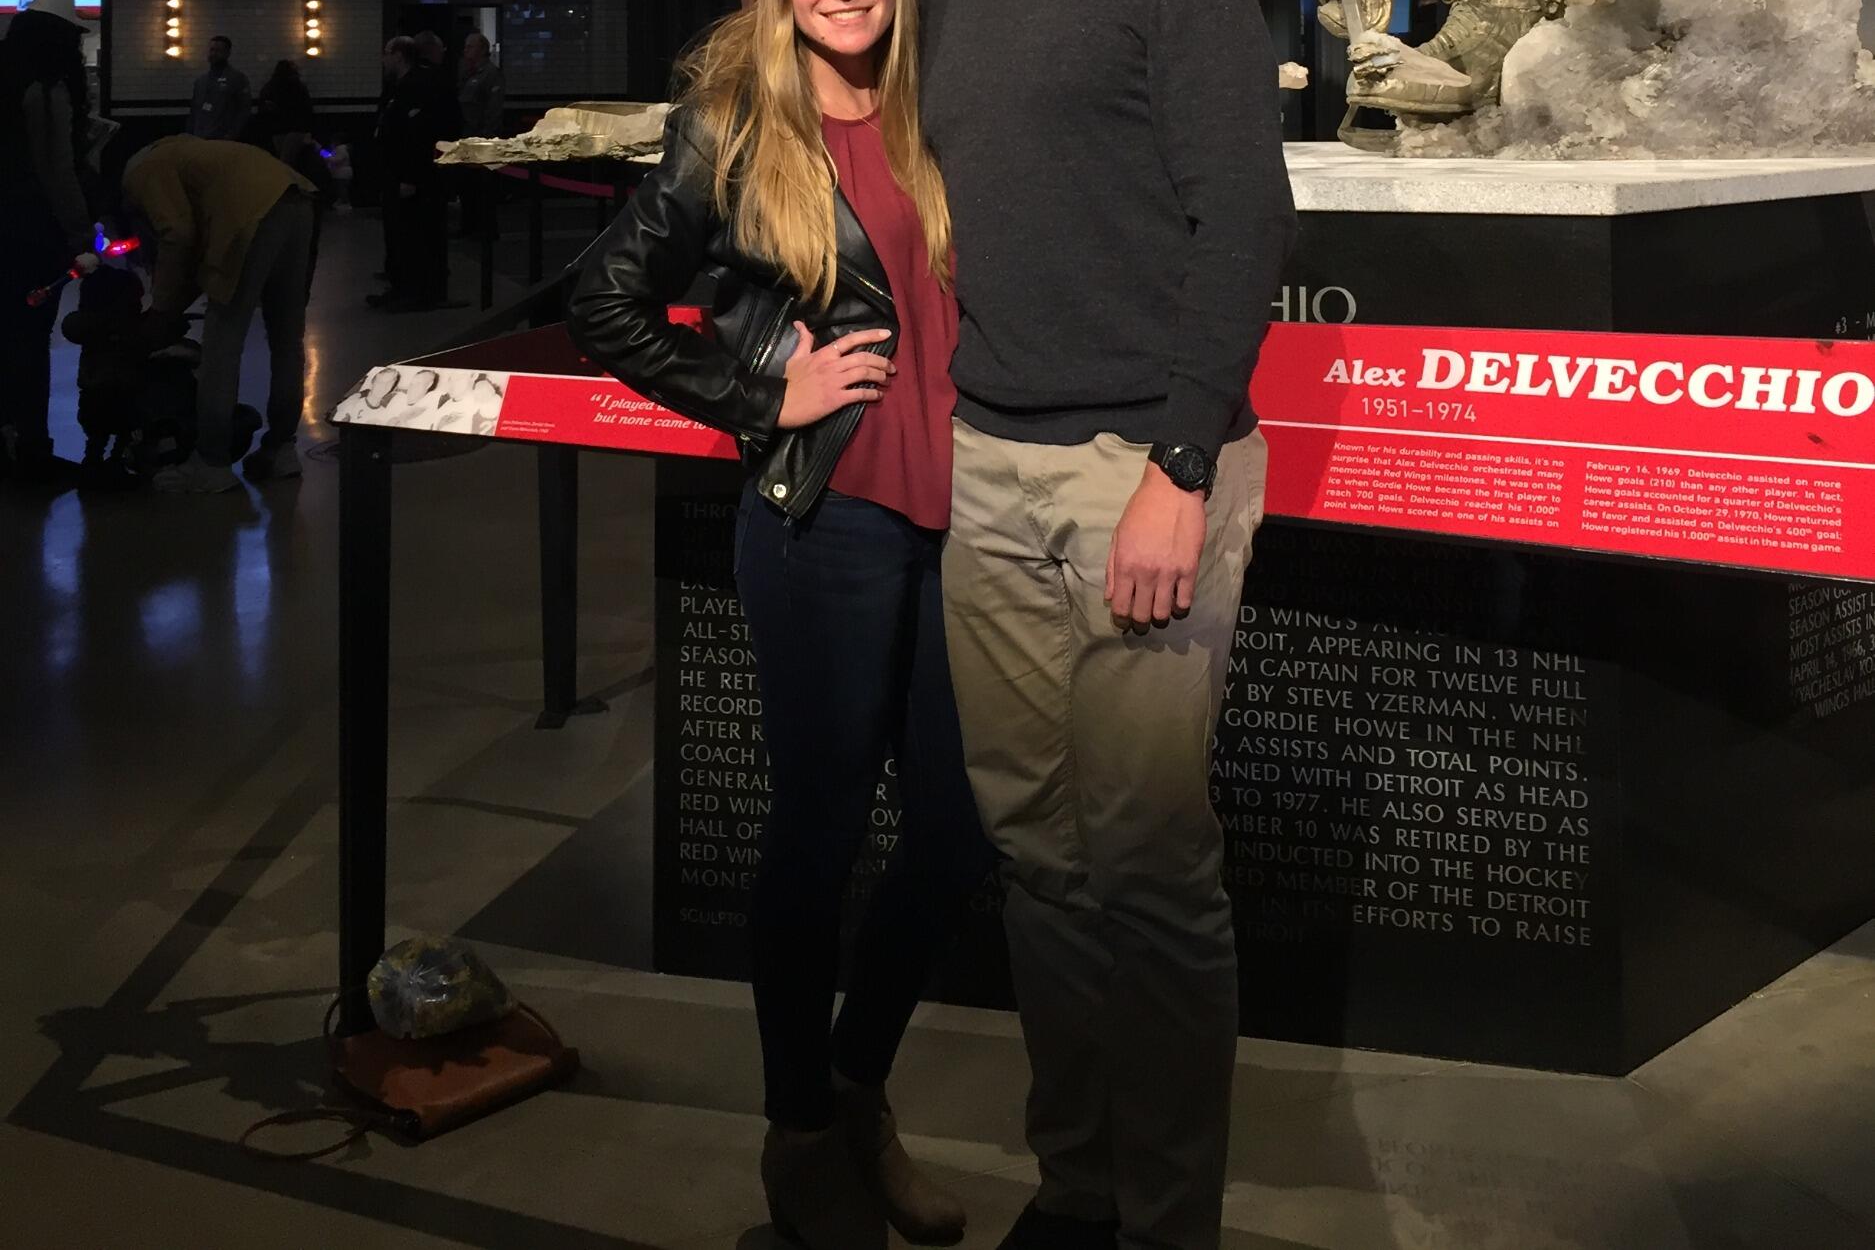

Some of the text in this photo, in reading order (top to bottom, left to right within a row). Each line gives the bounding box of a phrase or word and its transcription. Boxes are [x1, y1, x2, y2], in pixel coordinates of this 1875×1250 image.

[1323, 348, 1875, 416] Alex DELVECCHIO
[609, 397, 655, 412] played
[593, 413, 690, 430] but none came
[1333, 442, 1364, 451] Known
[1367, 444, 1380, 452] for
[1382, 446, 1396, 454] his
[1399, 447, 1441, 458] durability
[1444, 451, 1462, 459] and
[1465, 453, 1501, 463] passing
[1329, 466, 1380, 476] memorable
[1383, 468, 1401, 477] Red
[1403, 470, 1431, 481] Wings
[1493, 477, 1506, 486] He
[1509, 480, 1528, 488] was
[1546, 482, 1562, 490] the
[1332, 455, 1563, 479] surprise that Alex Delvecchio orchestrated many
[1586, 461, 1841, 488] February Delvecchio assisted more
[1327, 476, 1560, 502] ice when Gordie Howe became the first player to
[1584, 485, 1611, 494] Howe
[1613, 489, 1641, 497] goals
[1643, 491, 1694, 501] accounted
[1722, 498, 1761, 506] quarter
[1585, 473, 1759, 494] Howe goals (210) than other
[1323, 500, 1346, 508] point
[1350, 502, 1374, 510] when
[1377, 504, 1403, 513] Howe
[1407, 508, 1438, 516] scored
[1508, 516, 1543, 526] assists
[1326, 489, 1521, 511] reach 700 Delvecchio reached his
[1583, 498, 1841, 526] career October Howe returned
[1601, 511, 1627, 520] favor
[1654, 517, 1696, 527] assisted
[1581, 522, 1809, 549] Howe registered assist same
[1789, 587, 1830, 617] SEASON
[1789, 592, 1867, 639] SEASON ASSIST
[1307, 635, 1439, 662] APPEARING
[1455, 645, 1480, 664] IN
[1494, 648, 1517, 667] 13
[1533, 651, 1585, 673] NHL
[1790, 634, 1820, 661] MOST
[680, 669, 706, 688] HE
[1259, 658, 1357, 682] CAPTAIN
[1371, 666, 1416, 686] FOR
[1427, 670, 1517, 694] TWELVE
[1531, 678, 1586, 700] FULL
[680, 694, 763, 716] RECORD
[1247, 683, 1273, 702] BY
[1287, 686, 1352, 708] STEVE
[1509, 703, 1586, 726] WHEN
[1814, 689, 1850, 718] WINGS
[680, 719, 742, 740] AFTER
[1224, 707, 1585, 754] GORDIE HOWE IN THE NHL
[680, 743, 755, 766] COACH
[1236, 735, 1587, 781] ASSISTS AND TOTAL POINTS.
[680, 768, 774, 792] GENERAL
[1292, 765, 1350, 787] WITH
[1365, 772, 1464, 797] DETROIT
[1474, 781, 1505, 801] AS
[1519, 785, 1588, 808] HEAD
[680, 793, 719, 813] RED
[1235, 787, 1261, 806] TO
[1341, 796, 1369, 816] HE
[1382, 800, 1443, 822] ALSO
[1456, 806, 1546, 832] SERVED
[1557, 816, 1589, 836] AS
[680, 817, 764, 841] HALL OF
[1294, 819, 1316, 838] 10
[1330, 822, 1379, 844] WAS
[1395, 827, 1490, 853] RETIRED
[1504, 838, 1530, 857] BY
[1546, 841, 1589, 863] THE
[680, 842, 718, 862] RED
[1365, 852, 1419, 874] INTO
[1433, 858, 1473, 879] THE
[1487, 863, 1588, 889] HOCKEY
[1387, 881, 1418, 901] OF
[1429, 884, 1473, 906] THE
[1487, 890, 1590, 918] DETROIT
[1353, 905, 1590, 945] EFFORTS TO RAISE
